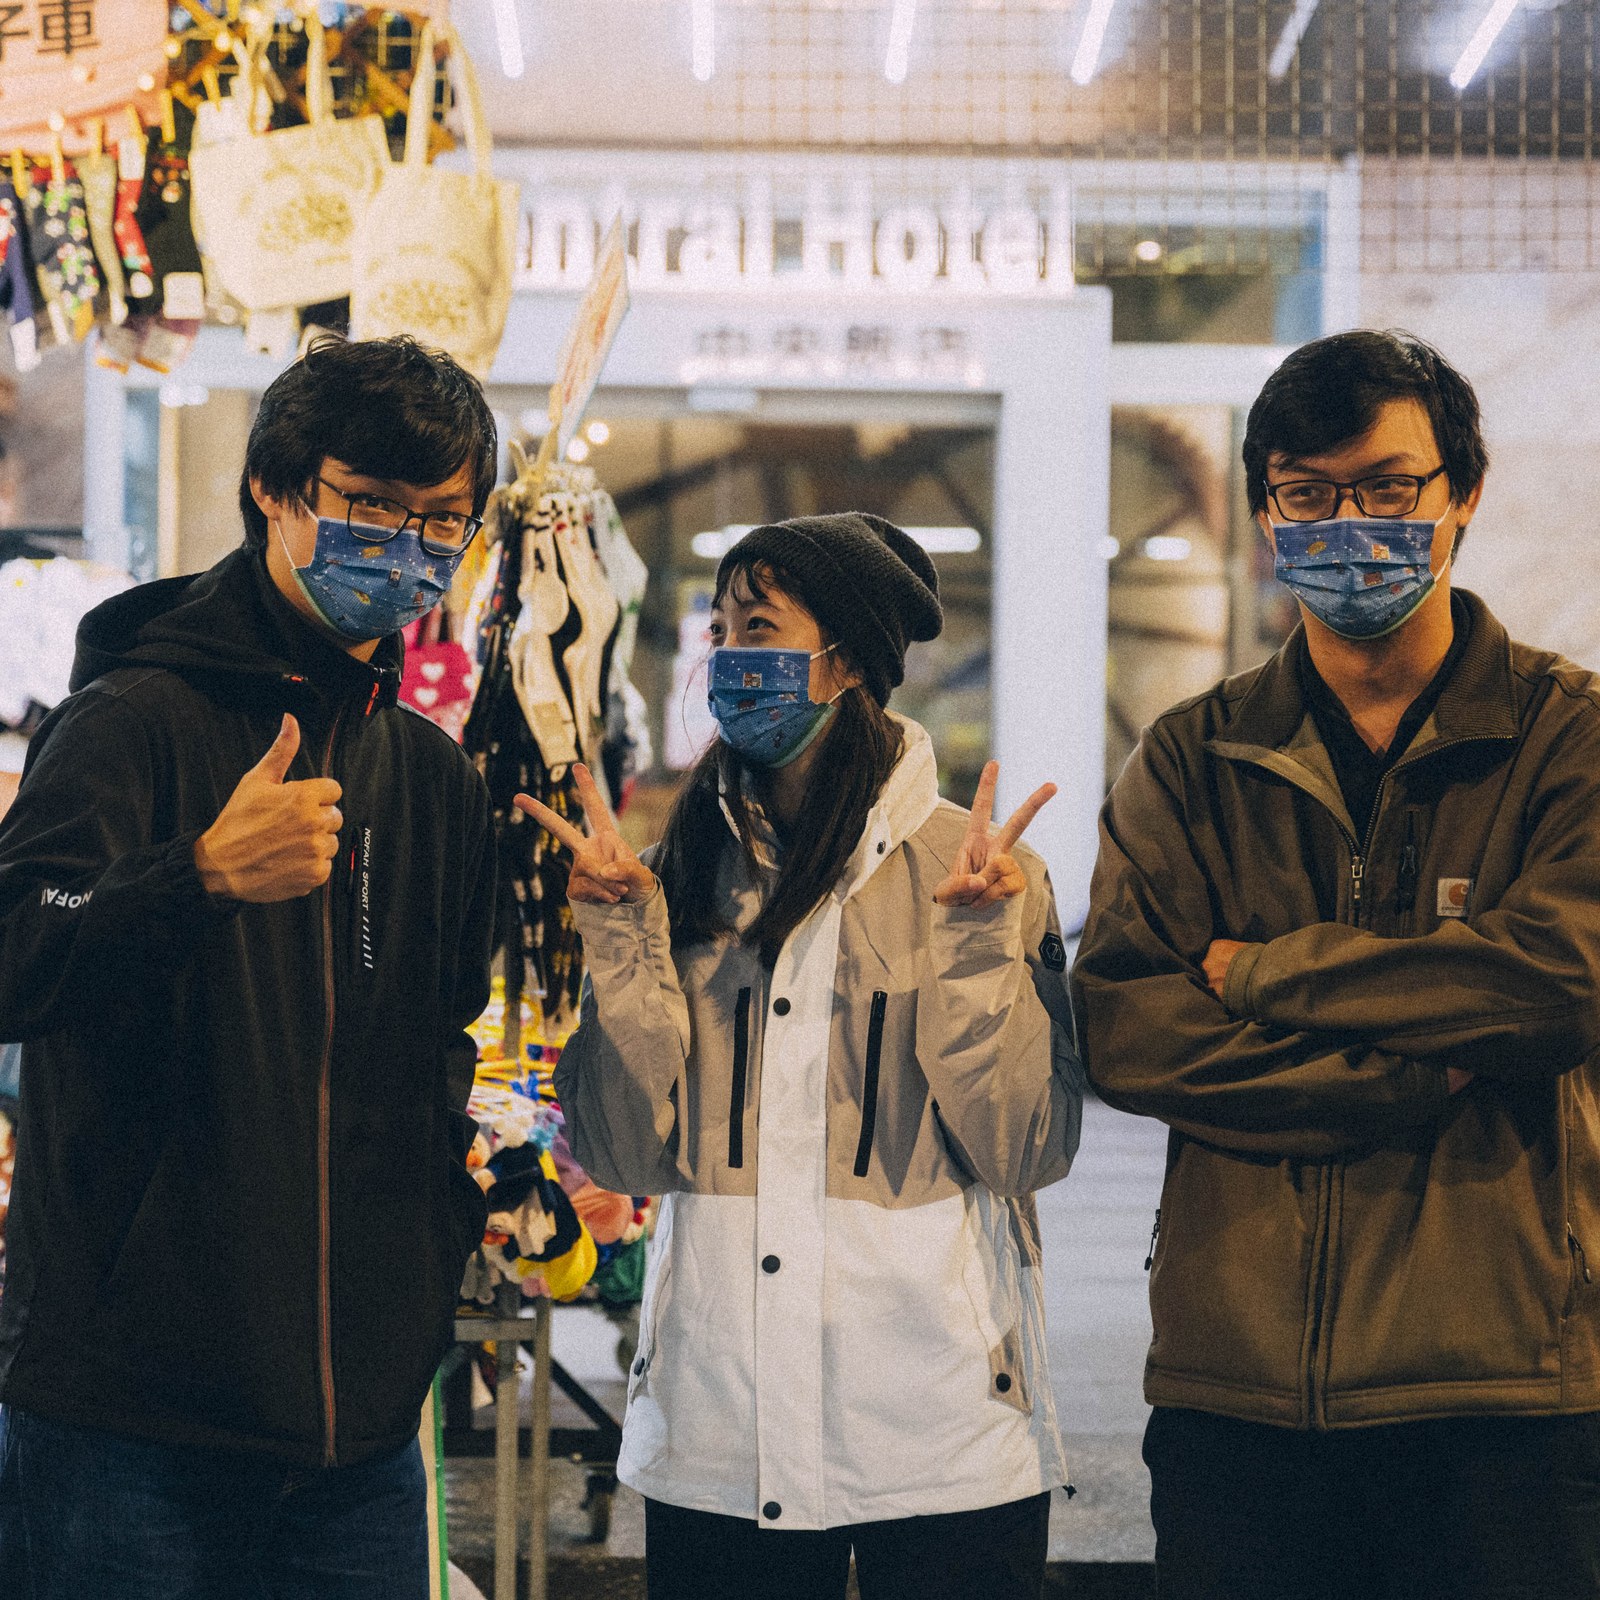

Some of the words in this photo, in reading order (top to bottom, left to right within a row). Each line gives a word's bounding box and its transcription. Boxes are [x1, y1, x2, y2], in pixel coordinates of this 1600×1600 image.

[802, 180, 1074, 288] Hotel
[362, 827, 371, 867] NOFAH
[361, 871, 369, 911] SPORT
